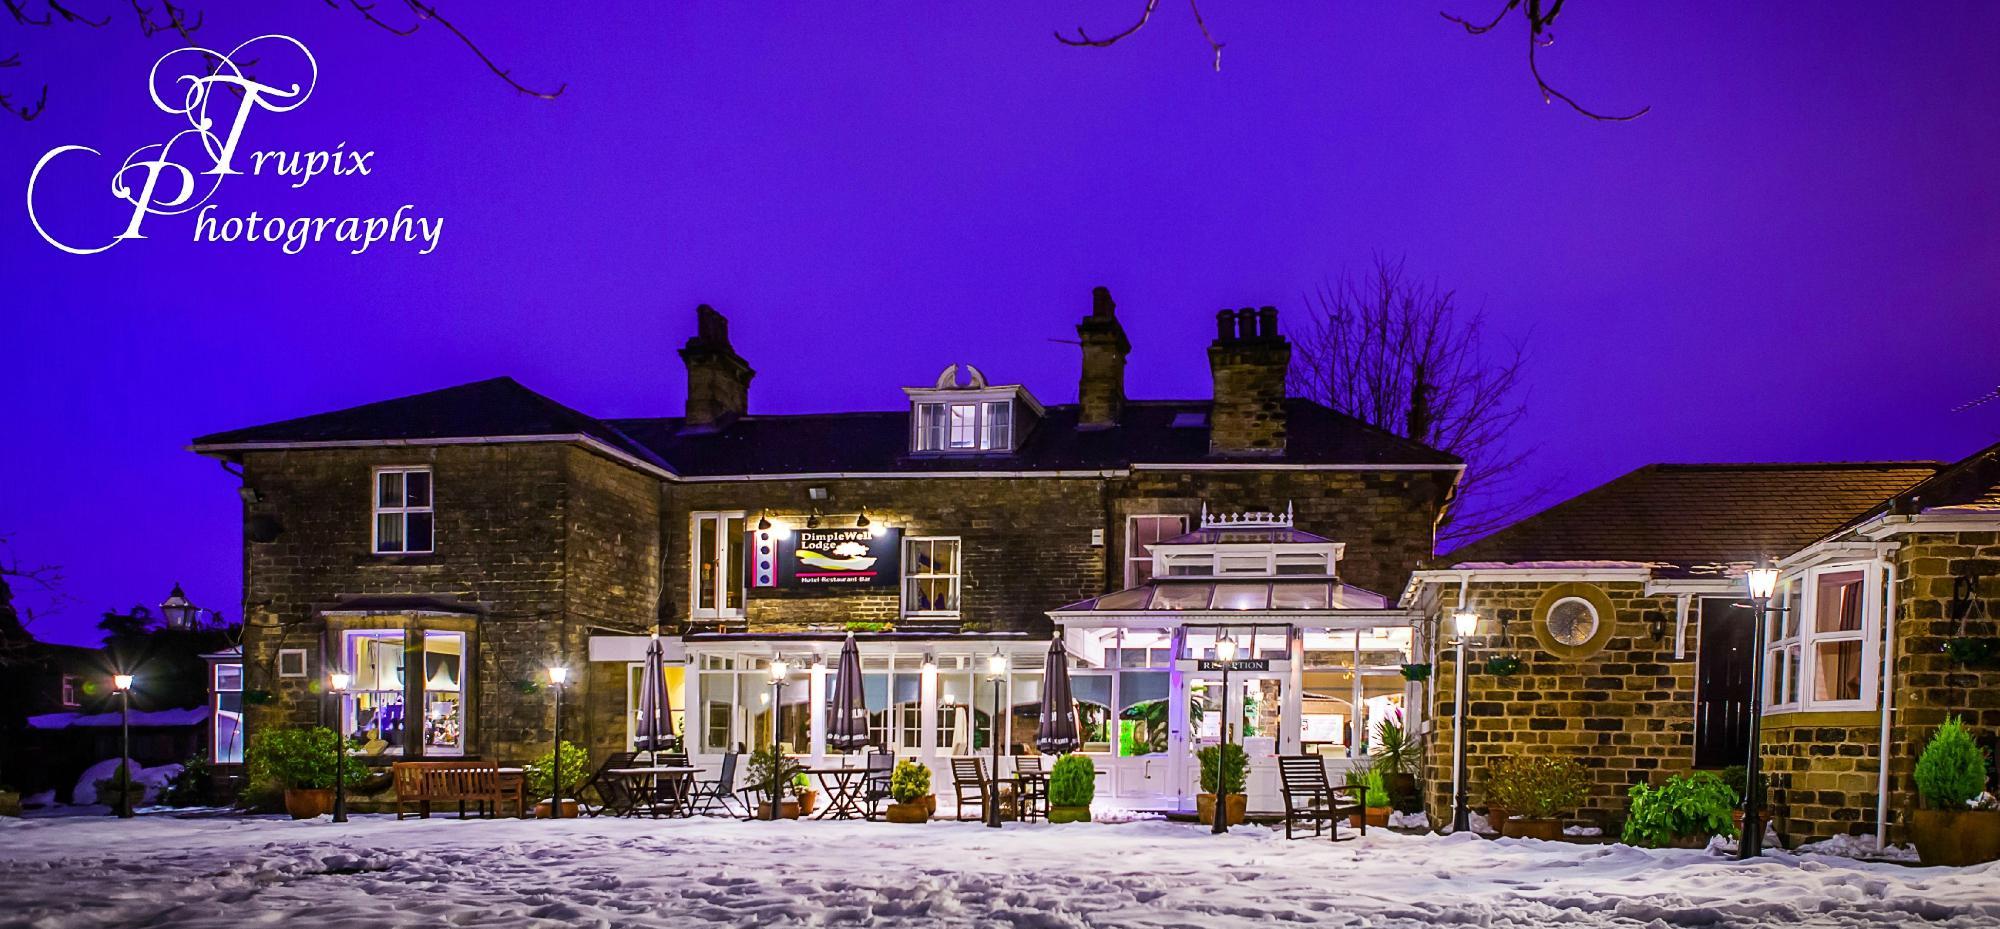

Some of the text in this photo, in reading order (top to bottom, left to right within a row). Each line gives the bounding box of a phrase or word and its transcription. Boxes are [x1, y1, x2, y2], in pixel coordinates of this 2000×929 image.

[801, 531, 873, 542] DimpleWell
[801, 541, 836, 551] Lodge
[1203, 661, 1263, 670] RPTION
